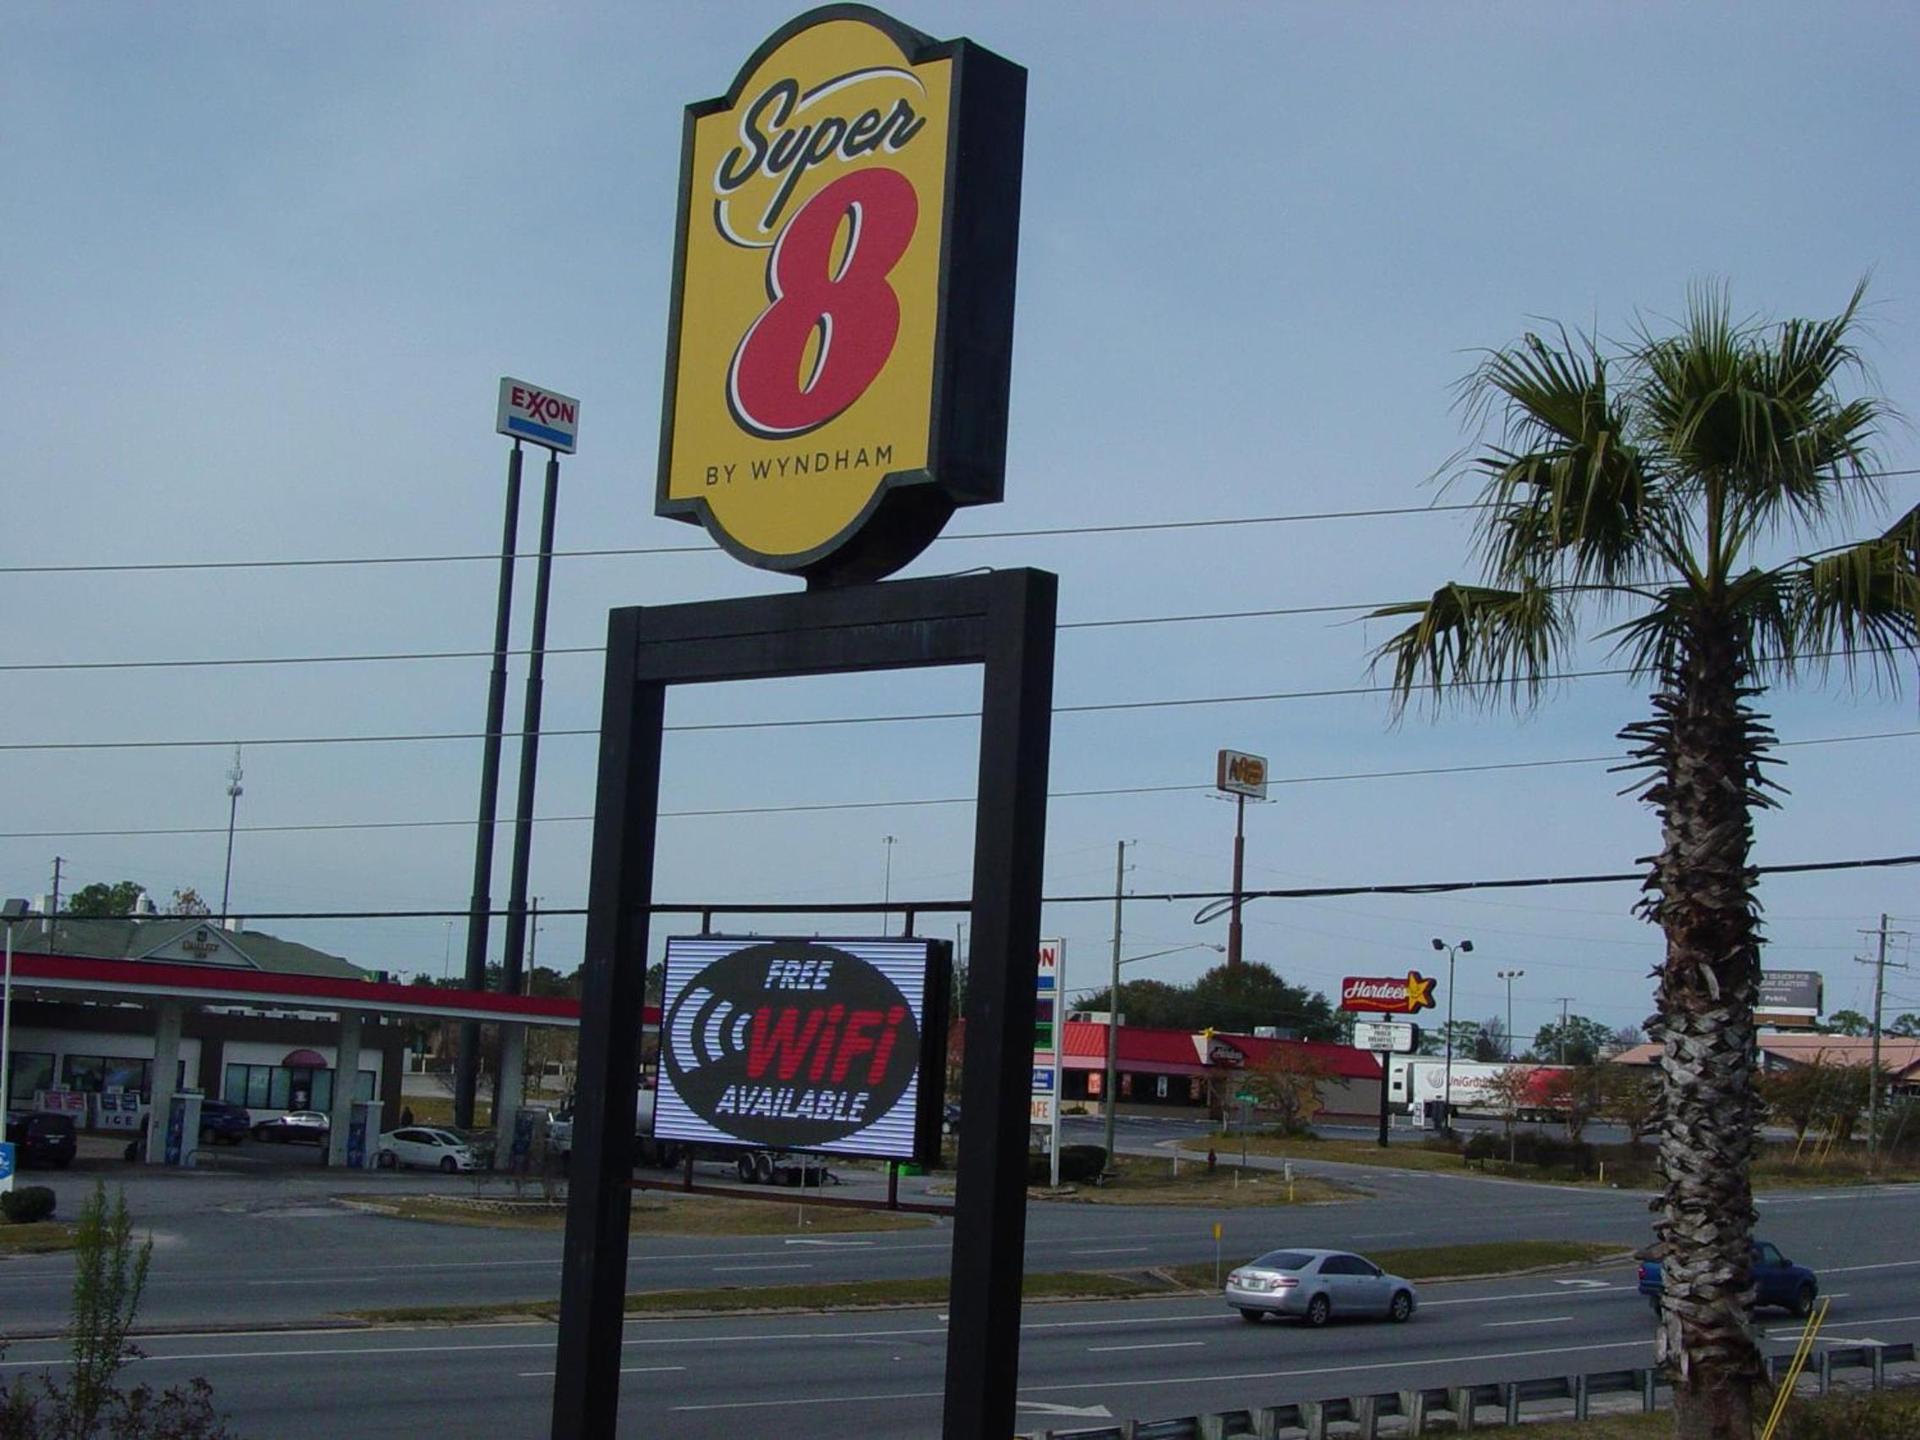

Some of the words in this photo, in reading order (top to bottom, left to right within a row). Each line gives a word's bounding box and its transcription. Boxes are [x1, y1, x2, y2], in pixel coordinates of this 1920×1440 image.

[715, 78, 926, 233] Super
[725, 167, 919, 441] 8
[511, 386, 574, 425] EXXON
[706, 456, 737, 486] BY
[751, 445, 893, 481] WYNDHAM
[764, 960, 834, 990] FREE
[746, 1003, 908, 1086] WiFi
[715, 1084, 870, 1122] AVAILABLE
